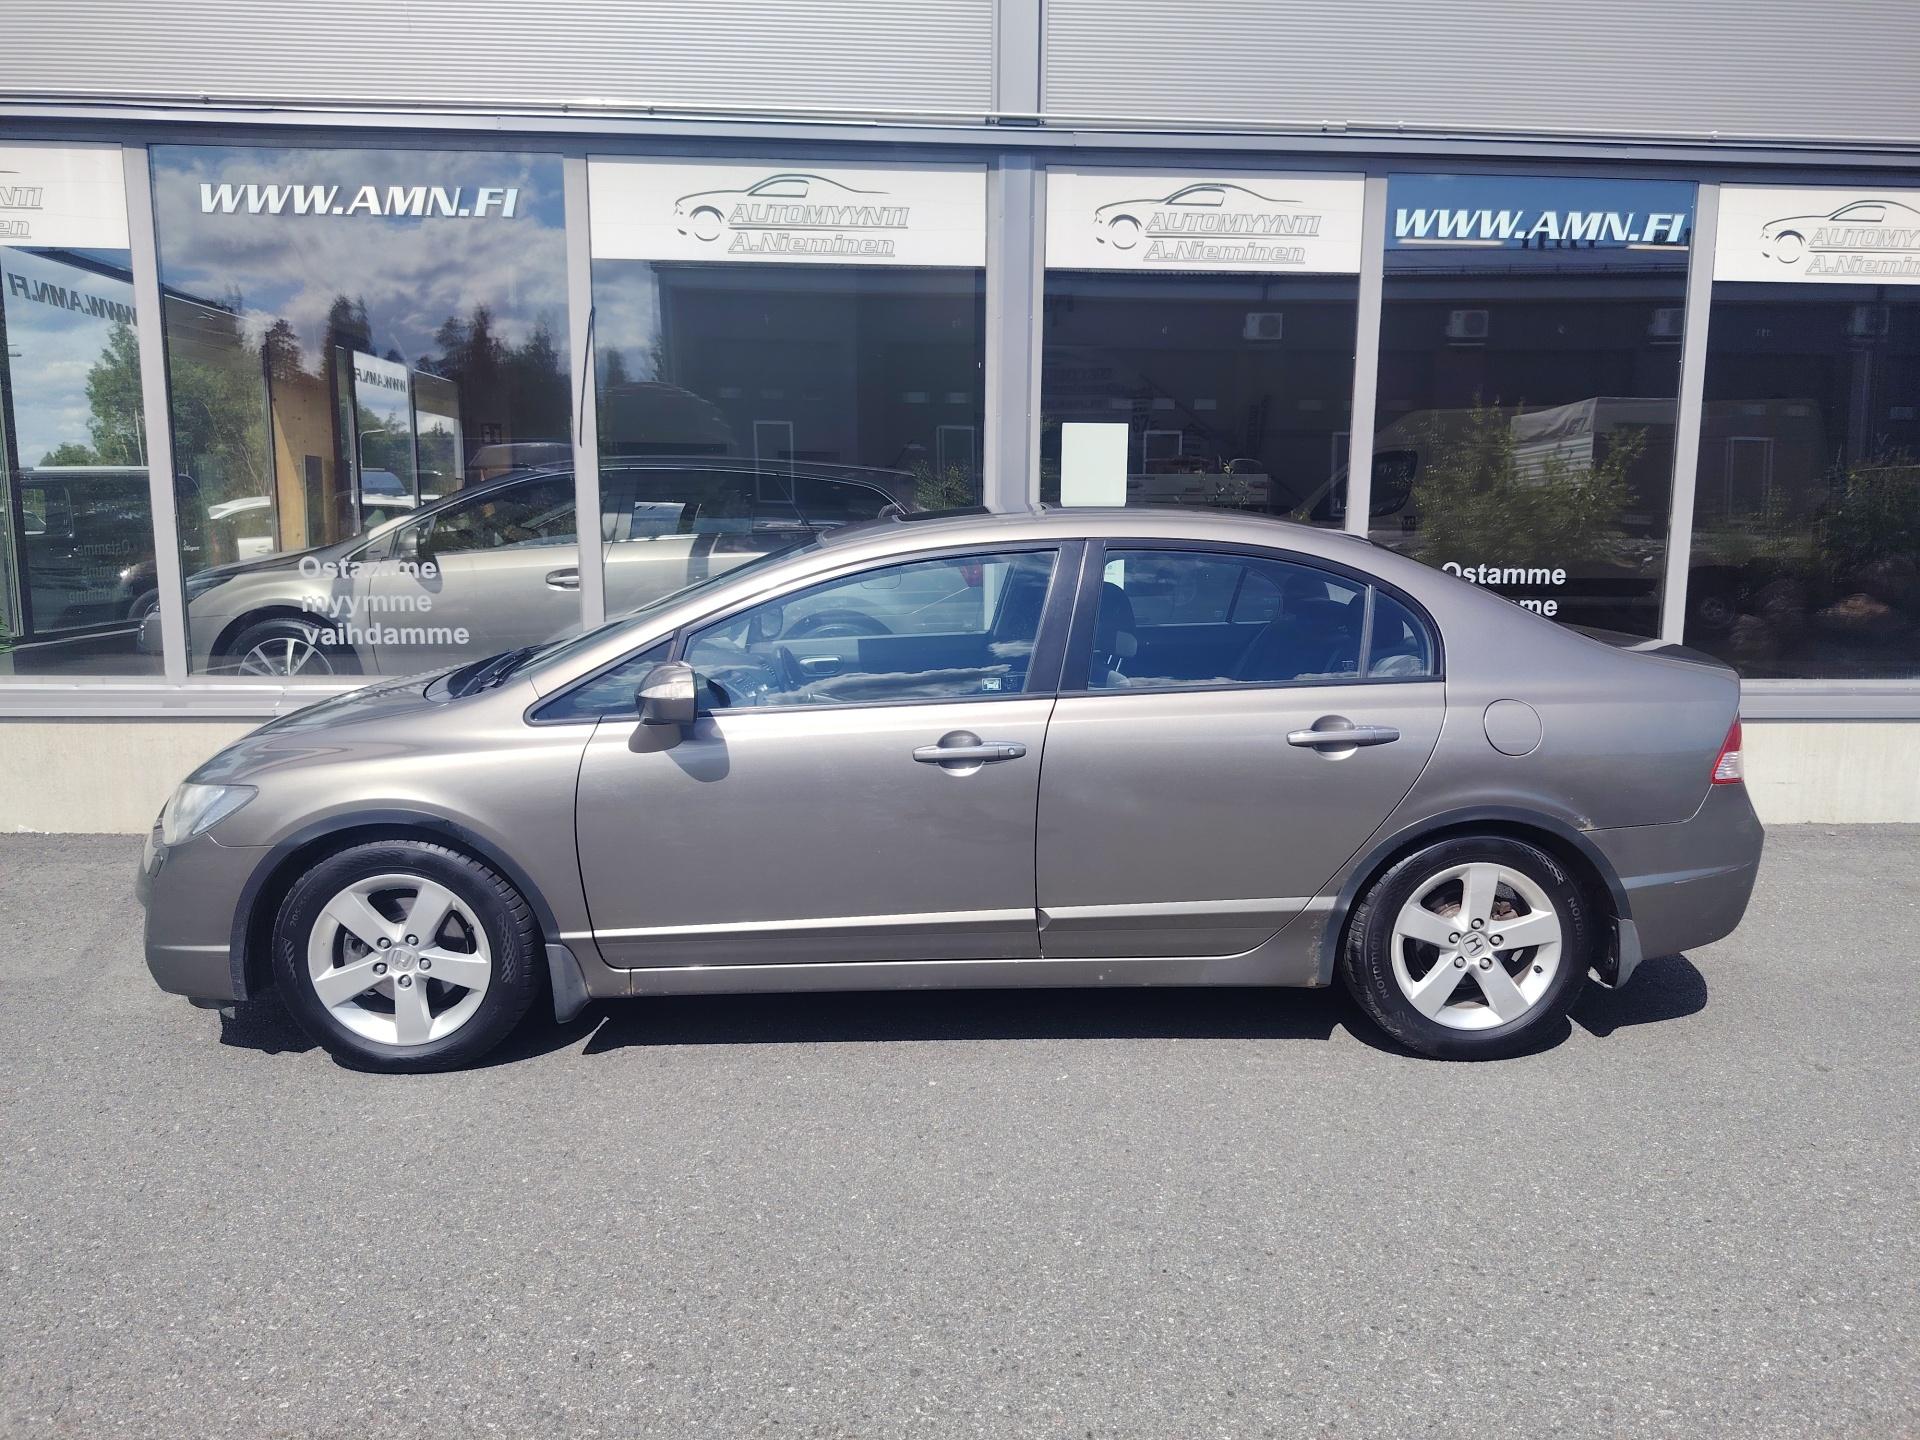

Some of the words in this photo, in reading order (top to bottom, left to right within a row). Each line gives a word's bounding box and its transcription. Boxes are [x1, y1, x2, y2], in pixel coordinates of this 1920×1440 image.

[199, 183, 519, 218] WWW.AMN.FI
[728, 203, 910, 226] AUTOMYYNTI
[1145, 212, 1322, 235] AUTOMYYNTI
[1395, 208, 1687, 243] WWW.AMN.FI
[728, 231, 895, 255] A.Nieminen
[1808, 227, 1920, 247] AUTOMY
[1144, 240, 1306, 263] A.Nieminen
[298, 556, 437, 579] Ostame
[302, 594, 432, 618] myymme
[302, 622, 470, 645] vaihdamme
